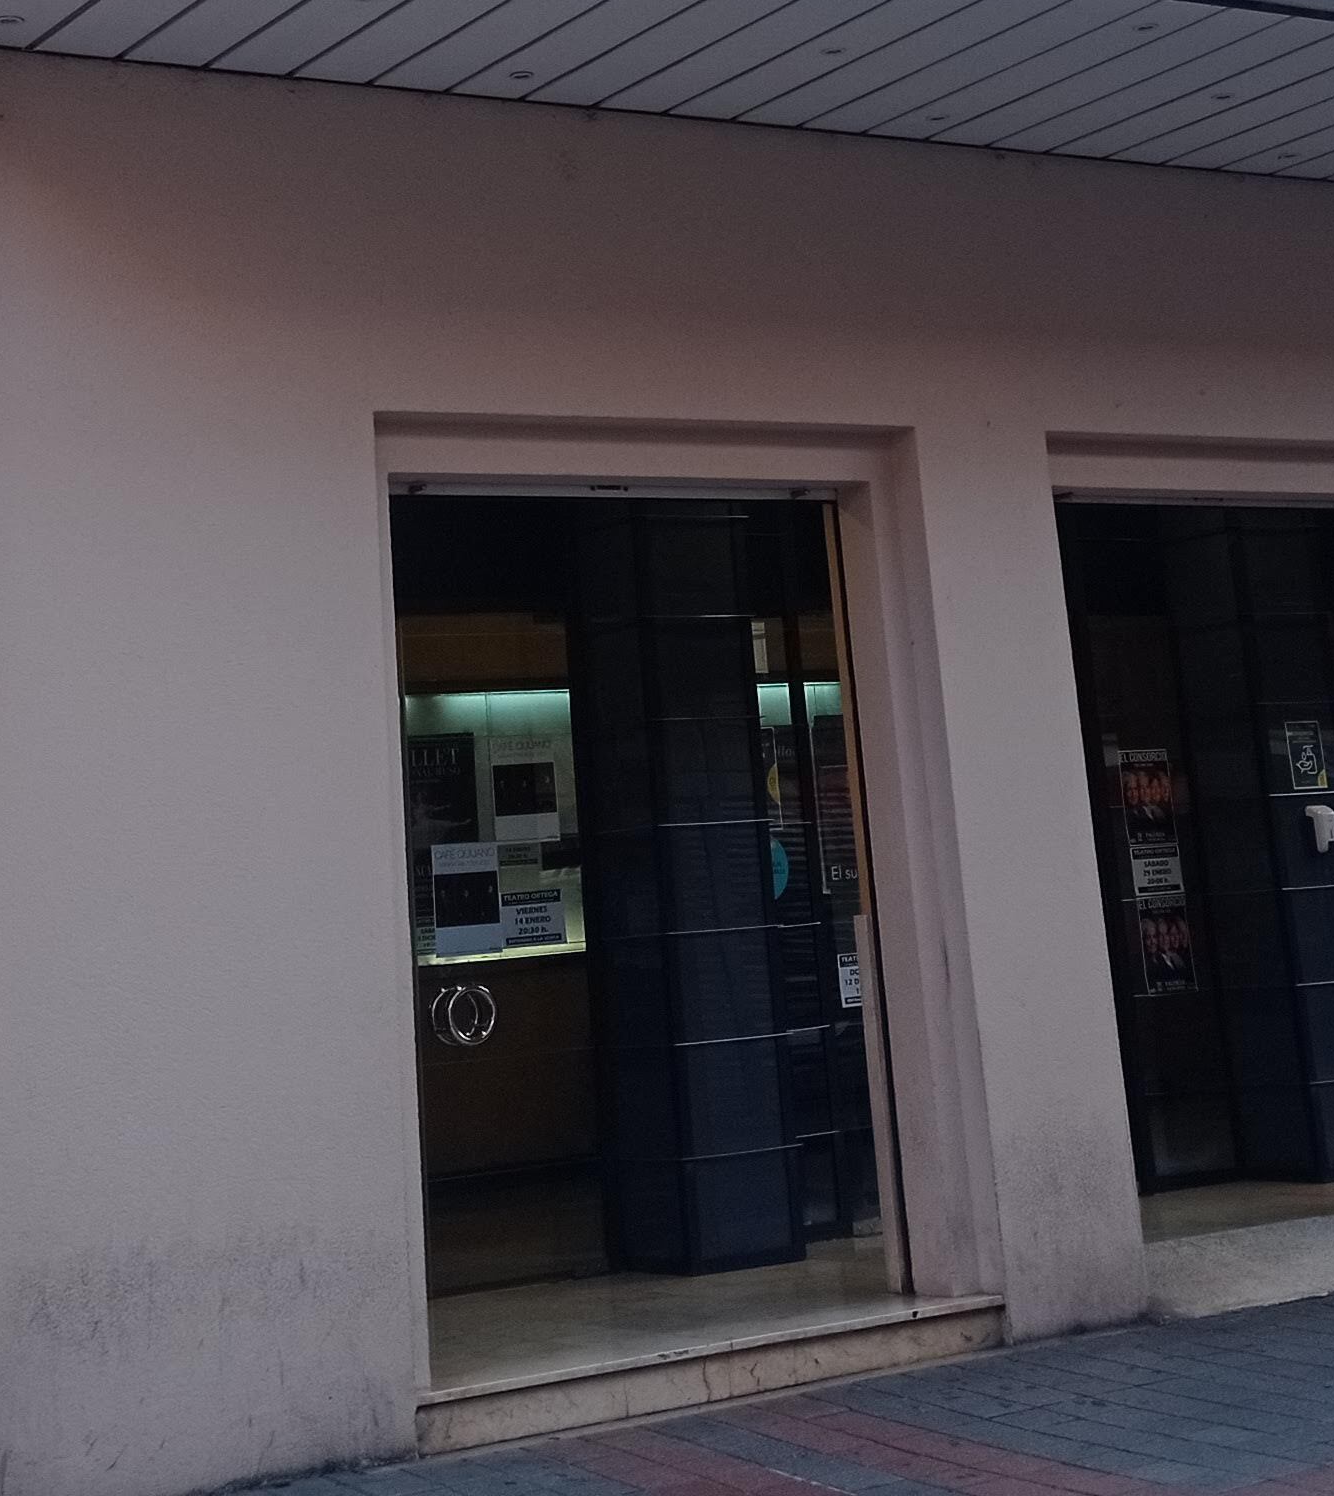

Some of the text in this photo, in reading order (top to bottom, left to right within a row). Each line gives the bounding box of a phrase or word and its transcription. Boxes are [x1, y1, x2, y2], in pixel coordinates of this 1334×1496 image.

[830, 865, 843, 881] El
[515, 905, 548, 915] VIERNES
[514, 915, 552, 925] 14 ENERO
